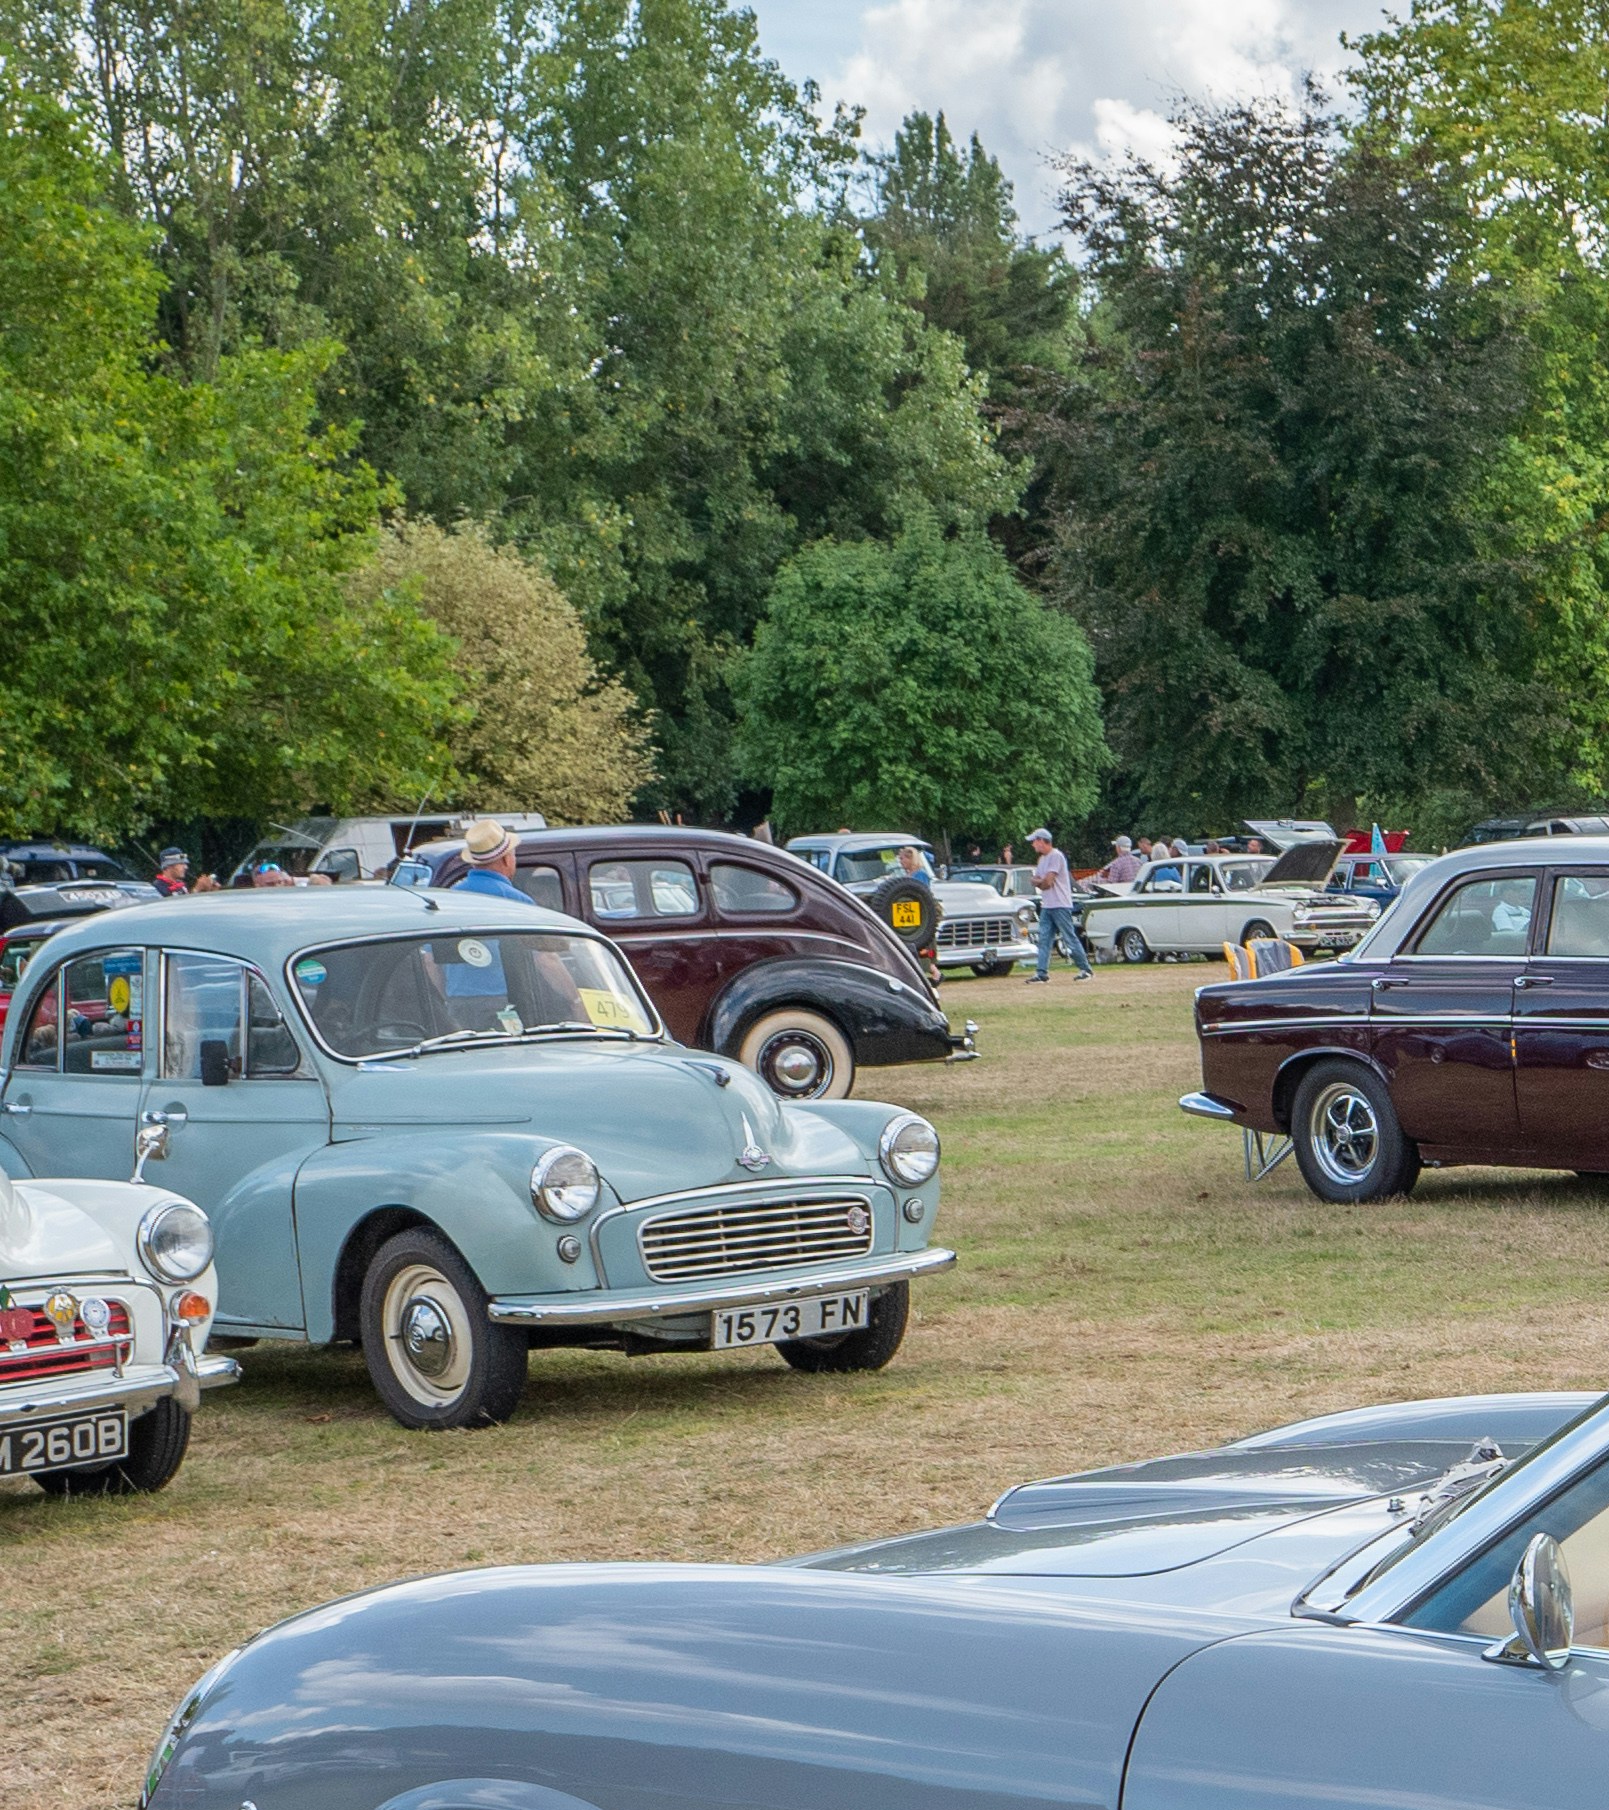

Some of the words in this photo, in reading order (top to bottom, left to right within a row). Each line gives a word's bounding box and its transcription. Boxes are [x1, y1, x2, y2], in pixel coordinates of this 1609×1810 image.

[897, 903, 914, 914] FSL
[900, 915, 914, 924] 441
[597, 1000, 630, 1019] 479
[722, 1304, 801, 1344] 1573
[819, 1295, 862, 1329] FN
[21, 1417, 123, 1469] 260B
